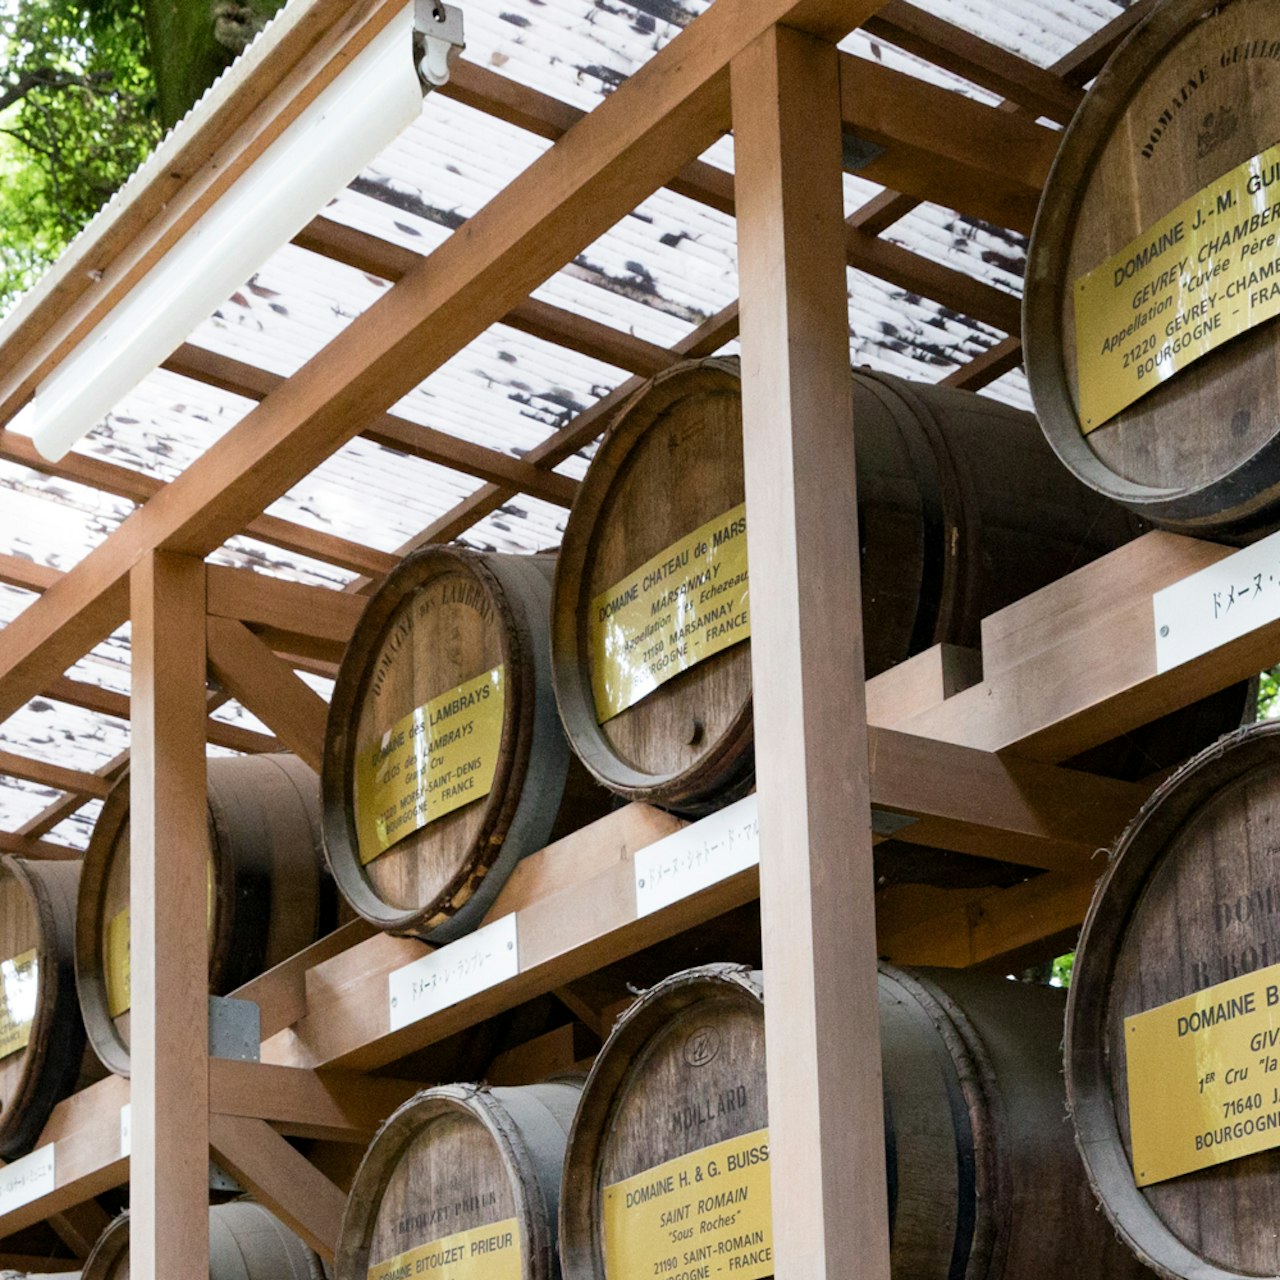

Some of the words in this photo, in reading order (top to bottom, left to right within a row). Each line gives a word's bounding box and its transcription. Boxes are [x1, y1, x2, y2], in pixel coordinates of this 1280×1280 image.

[1141, 65, 1210, 160] DOMAINE
[1114, 222, 1184, 288] DOMAINE
[1192, 190, 1237, 230] J.-M.
[1101, 295, 1173, 354] Appellation
[1241, 232, 1275, 261] Père
[1132, 257, 1188, 309] GEVREY
[1123, 333, 1156, 368] 21220
[1137, 314, 1222, 380] BOURGOGNE
[599, 584, 639, 623] DOMAINE
[642, 550, 689, 592] CHATEAU
[694, 541, 708, 559] de
[650, 563, 721, 617] MARSANNAY
[700, 571, 748, 603] Echezeau
[670, 601, 734, 645] MARSANNAY
[706, 612, 748, 642] FRANCE
[409, 723, 425, 739] des
[430, 685, 490, 727] LAMBRAYS
[424, 721, 474, 757] LAMBRAYS
[400, 756, 482, 809] MOREY-SAINT-DENIS
[431, 756, 445, 769] Cru
[387, 803, 428, 835] BOURGOGNE
[442, 777, 475, 801] FRANCE
[1177, 993, 1256, 1038] DOMAINE
[1225, 1066, 1248, 1086] Cru
[1259, 1054, 1280, 1076] "la
[672, 1084, 746, 1133] MOILLARD
[1223, 1093, 1263, 1119] 71640
[626, 1176, 674, 1208] DOMAINE
[679, 1171, 691, 1188] H.
[695, 1166, 704, 1182] &
[707, 1161, 721, 1178] G.
[727, 1145, 769, 1172] BUISS
[660, 1204, 690, 1228] SAINT
[697, 1187, 748, 1215] ROMAIN
[700, 1210, 741, 1234] Roches"
[416, 1245, 465, 1274] BITOUZET
[471, 1232, 513, 1257] PRIEUR
[654, 1257, 678, 1275] 21190
[683, 1230, 763, 1265] SAINT-ROMAIN
[729, 1247, 772, 1271] FRANCE
